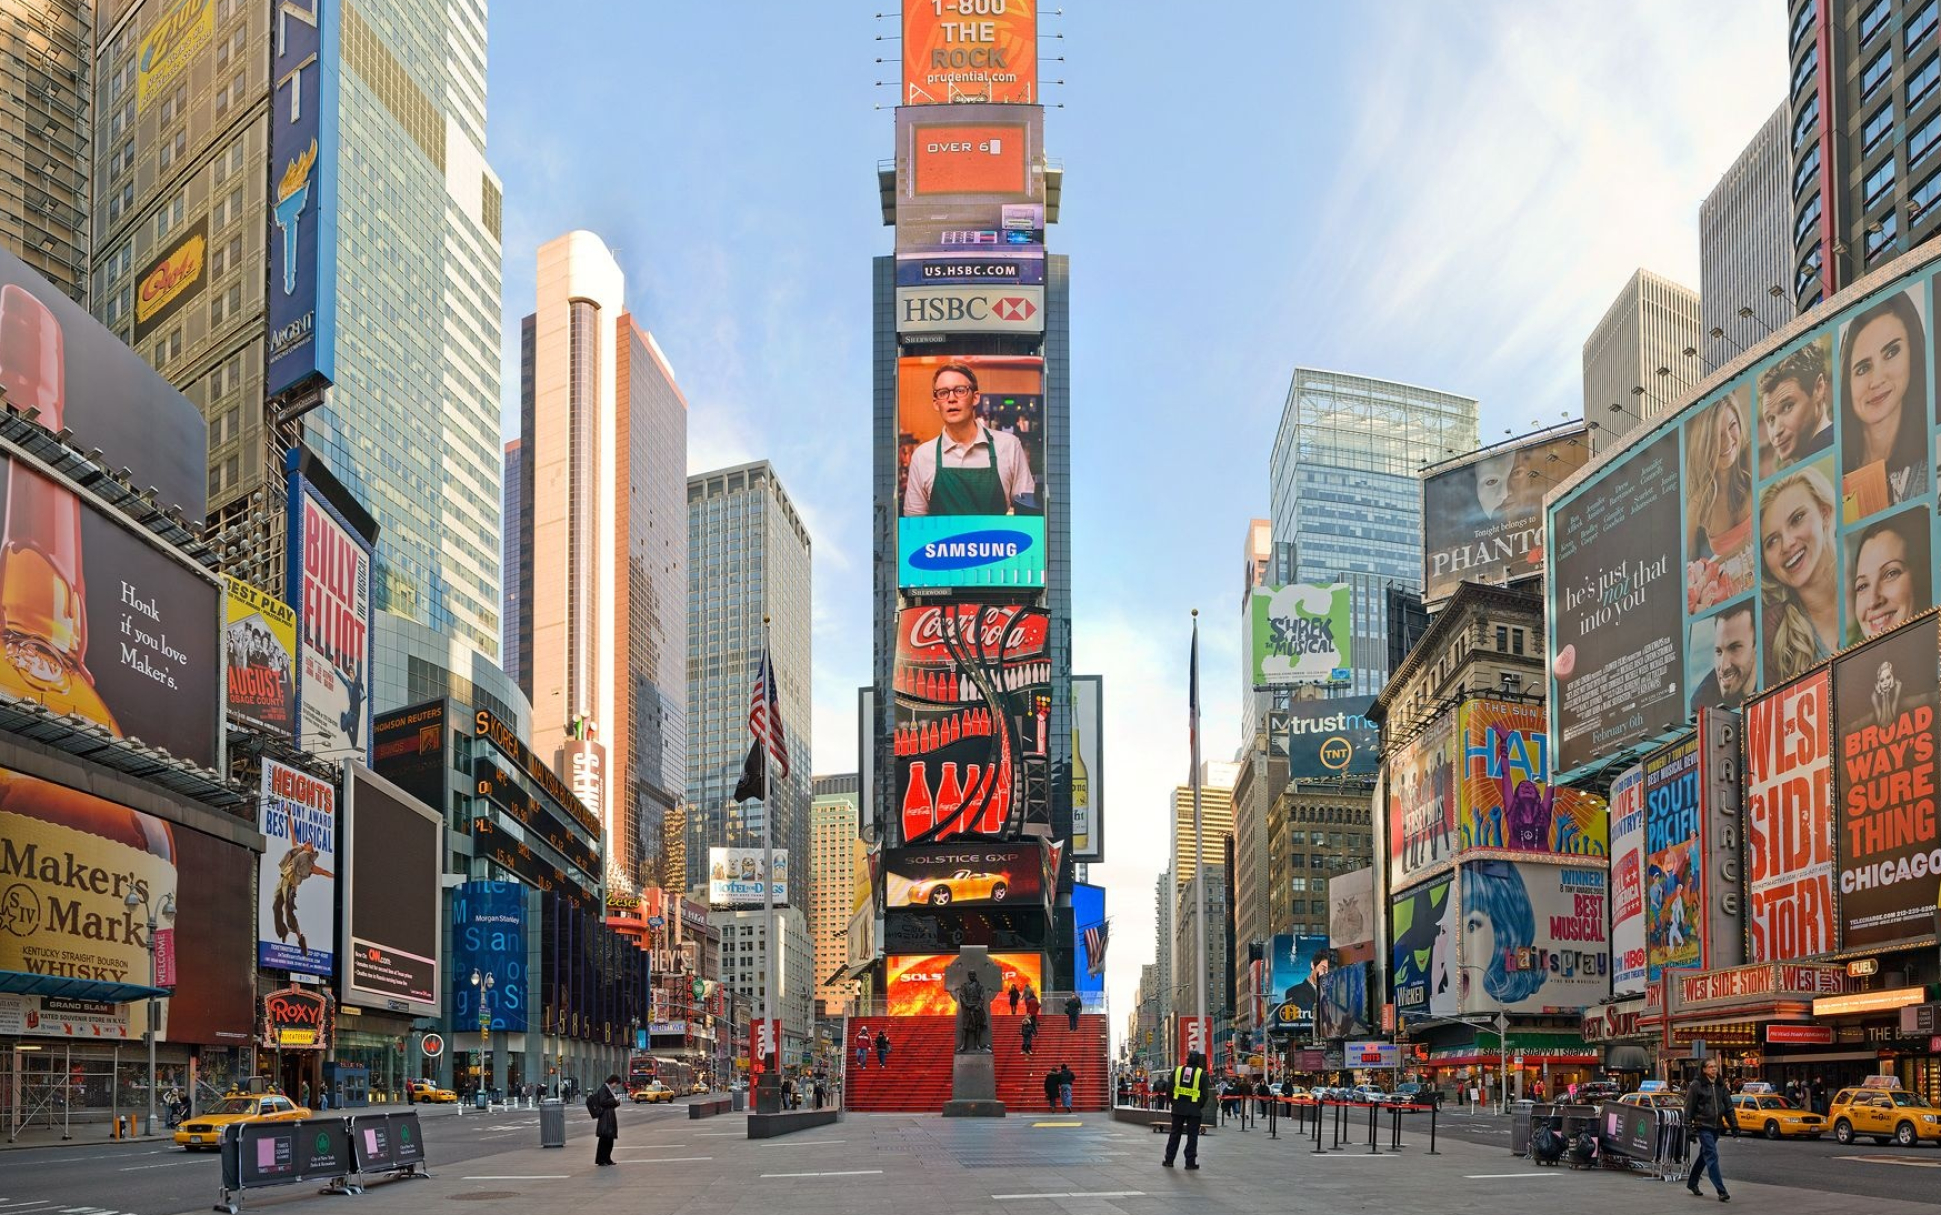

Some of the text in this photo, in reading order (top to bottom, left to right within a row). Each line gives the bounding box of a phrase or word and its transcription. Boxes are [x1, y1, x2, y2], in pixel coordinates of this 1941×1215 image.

[941, 22, 995, 42] THE
[931, 48, 1007, 69] ROCK
[927, 71, 1017, 84] prudential.com
[927, 142, 972, 153] OVER
[924, 266, 1016, 277] US.HSBC.COM
[903, 296, 988, 322] HSBC
[1474, 515, 1537, 539] Tonight belongs to
[304, 502, 359, 611] BILLY
[925, 542, 1017, 558] SAMSUNG
[1566, 553, 1669, 612] he's just that
[1603, 576, 1631, 606] not
[120, 580, 161, 622] Honk
[226, 576, 294, 622] BEST PLAY
[1580, 588, 1647, 636] into you
[120, 613, 188, 665] if you love
[304, 574, 366, 678] ELLIOT
[1268, 616, 1334, 644] SHREK
[1273, 638, 1335, 657] MUSICAL
[120, 641, 178, 691] Maker's.
[229, 694, 284, 707] OSAGE COUNTY
[1484, 702, 1536, 717] THE SUN
[407, 707, 442, 725] REUTERS
[1592, 719, 1628, 745] February
[1629, 711, 1644, 728] 6th
[476, 711, 519, 759] S KOREA
[1748, 676, 1829, 787] WEST
[1845, 705, 1934, 758] BROAD
[1325, 749, 1348, 759] TNT
[1845, 732, 1934, 784] WAY'S
[271, 764, 333, 814] HEIGHTS
[1847, 761, 1935, 817] SURE
[289, 801, 306, 819] TONY
[309, 809, 332, 829] AWARD
[1717, 722, 1737, 916] PALACE
[1750, 767, 1833, 883] SIDE
[1847, 798, 1936, 858] THING
[266, 810, 333, 853] BEST MUSICAL
[0, 837, 149, 904] Maker's
[904, 853, 1018, 865] SOLSTICE GXP
[1840, 848, 1941, 894] CHICAGO
[754, 882, 784, 894] DGS
[1561, 869, 1604, 887] WINNER!
[474, 914, 499, 924] Morgan
[1573, 893, 1604, 920] BEST
[1751, 874, 1834, 963] STORY
[45, 895, 149, 948] Mark
[1549, 916, 1606, 942] MUSICAL
[22, 945, 129, 969] KENTUCKY STRAIGHT BOURBON
[23, 957, 128, 983] WHISKY
[156, 933, 166, 984] WELCOME
[1623, 947, 1645, 970] HBO
[1851, 960, 1873, 975] FUEL
[1682, 965, 1771, 1001] WEST SIDE STORY
[1780, 964, 1817, 992] WEST
[49, 1001, 108, 1012] GRAND SLAM
[1397, 985, 1424, 1007] WICKED
[60, 1014, 87, 1023] SOUVENIR
[89, 1016, 105, 1024] STORE
[270, 998, 319, 1024] ROXY
[1868, 1027, 1891, 1041] THE
[1522, 1048, 1555, 1056] sbarro
[1562, 1048, 1594, 1056] sbarro
